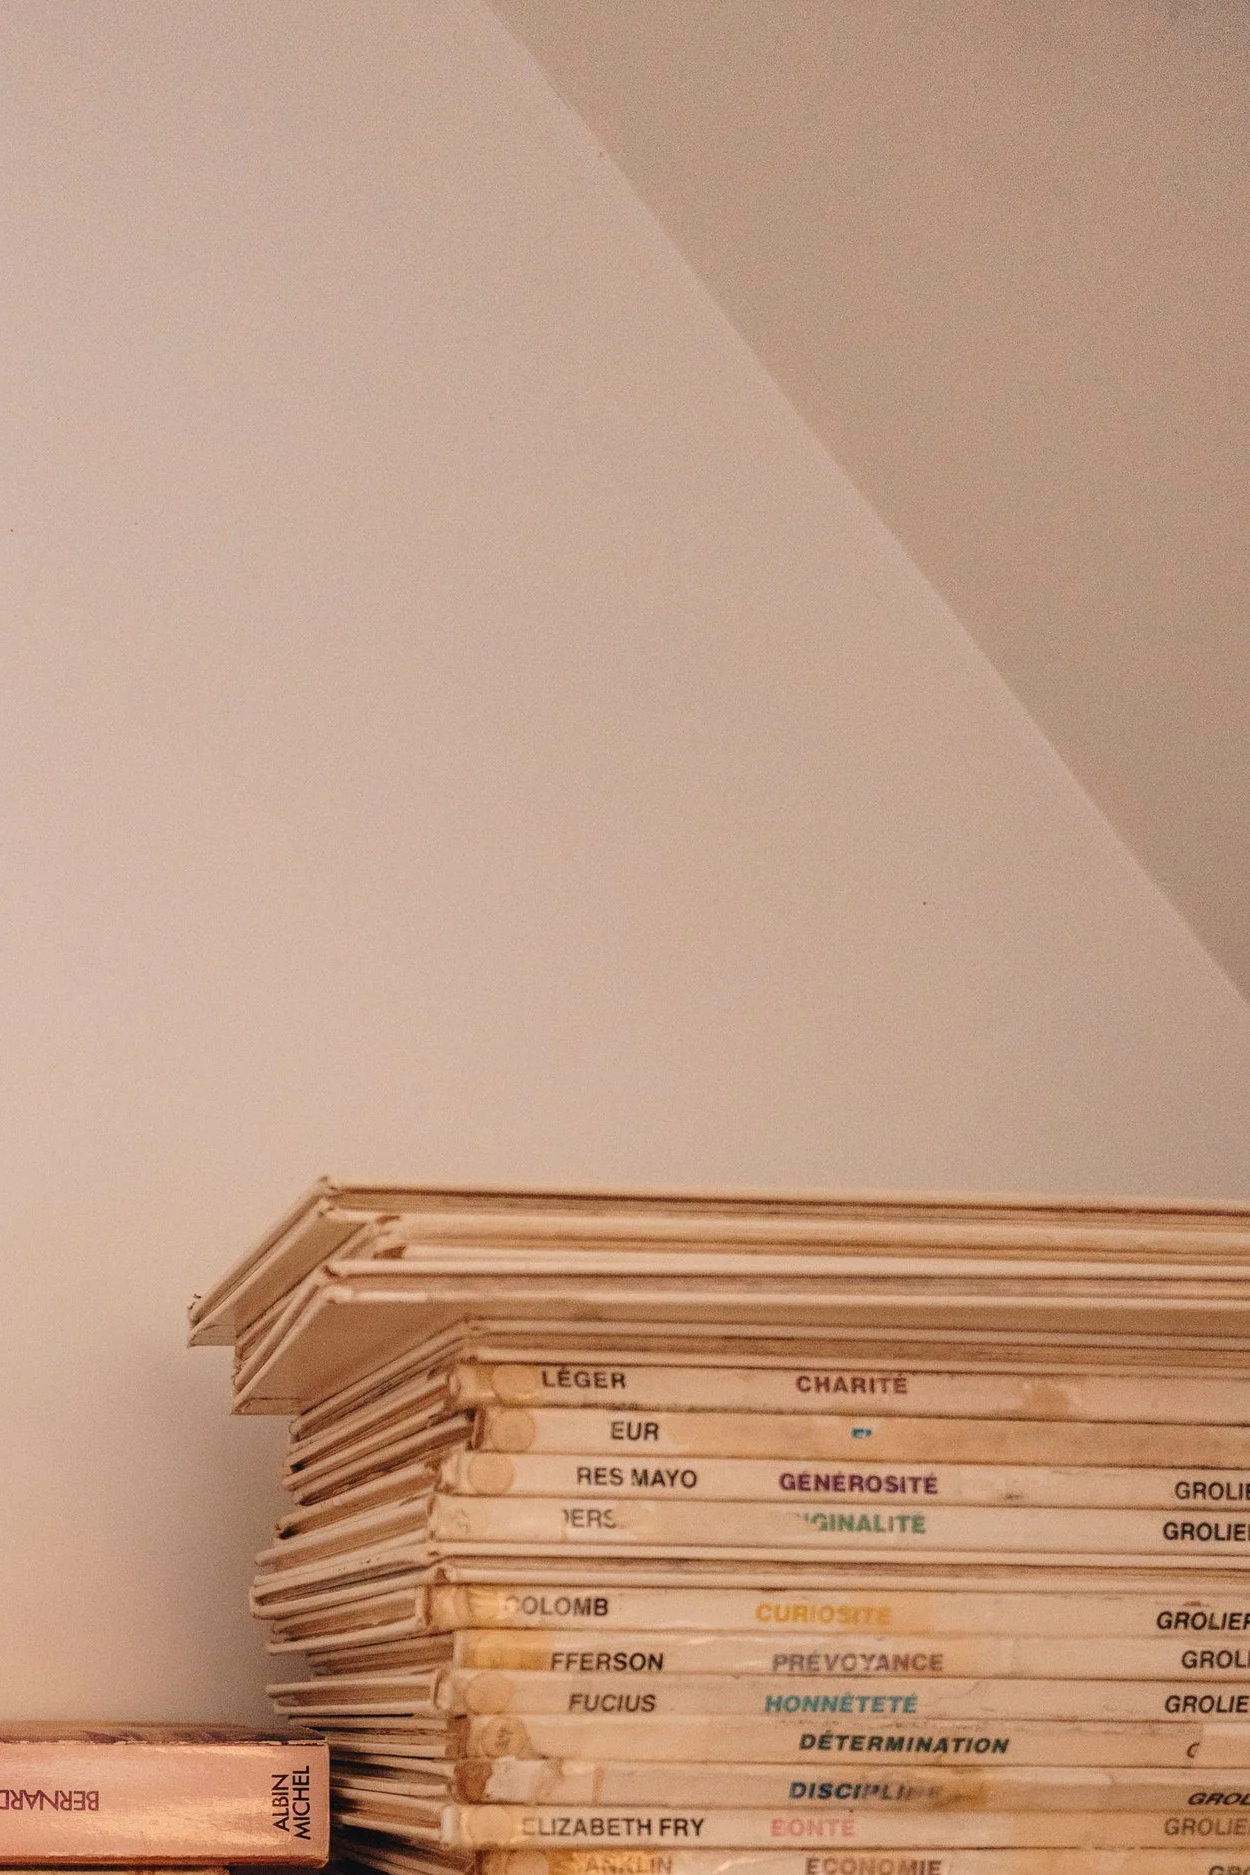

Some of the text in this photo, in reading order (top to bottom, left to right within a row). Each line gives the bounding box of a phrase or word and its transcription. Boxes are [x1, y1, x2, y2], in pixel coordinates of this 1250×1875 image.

[541, 1367, 626, 1388] LÉGER
[796, 1371, 907, 1394] CHARITÉ
[610, 1422, 659, 1441] EUR
[577, 1467, 697, 1489] RES MAYO
[779, 1469, 938, 1496] GÉNÉROSITÉ
[551, 1652, 664, 1671] FFERSON
[772, 1650, 944, 1673] PRÉVOYANCE
[568, 1694, 657, 1713] FUCIUS
[799, 1730, 1010, 1754] DÉTERMINATION
[271, 1773, 290, 1832] ALBIN
[293, 1765, 311, 1840] MICHEL
[522, 1817, 705, 1838] ELIZABETH FRY
